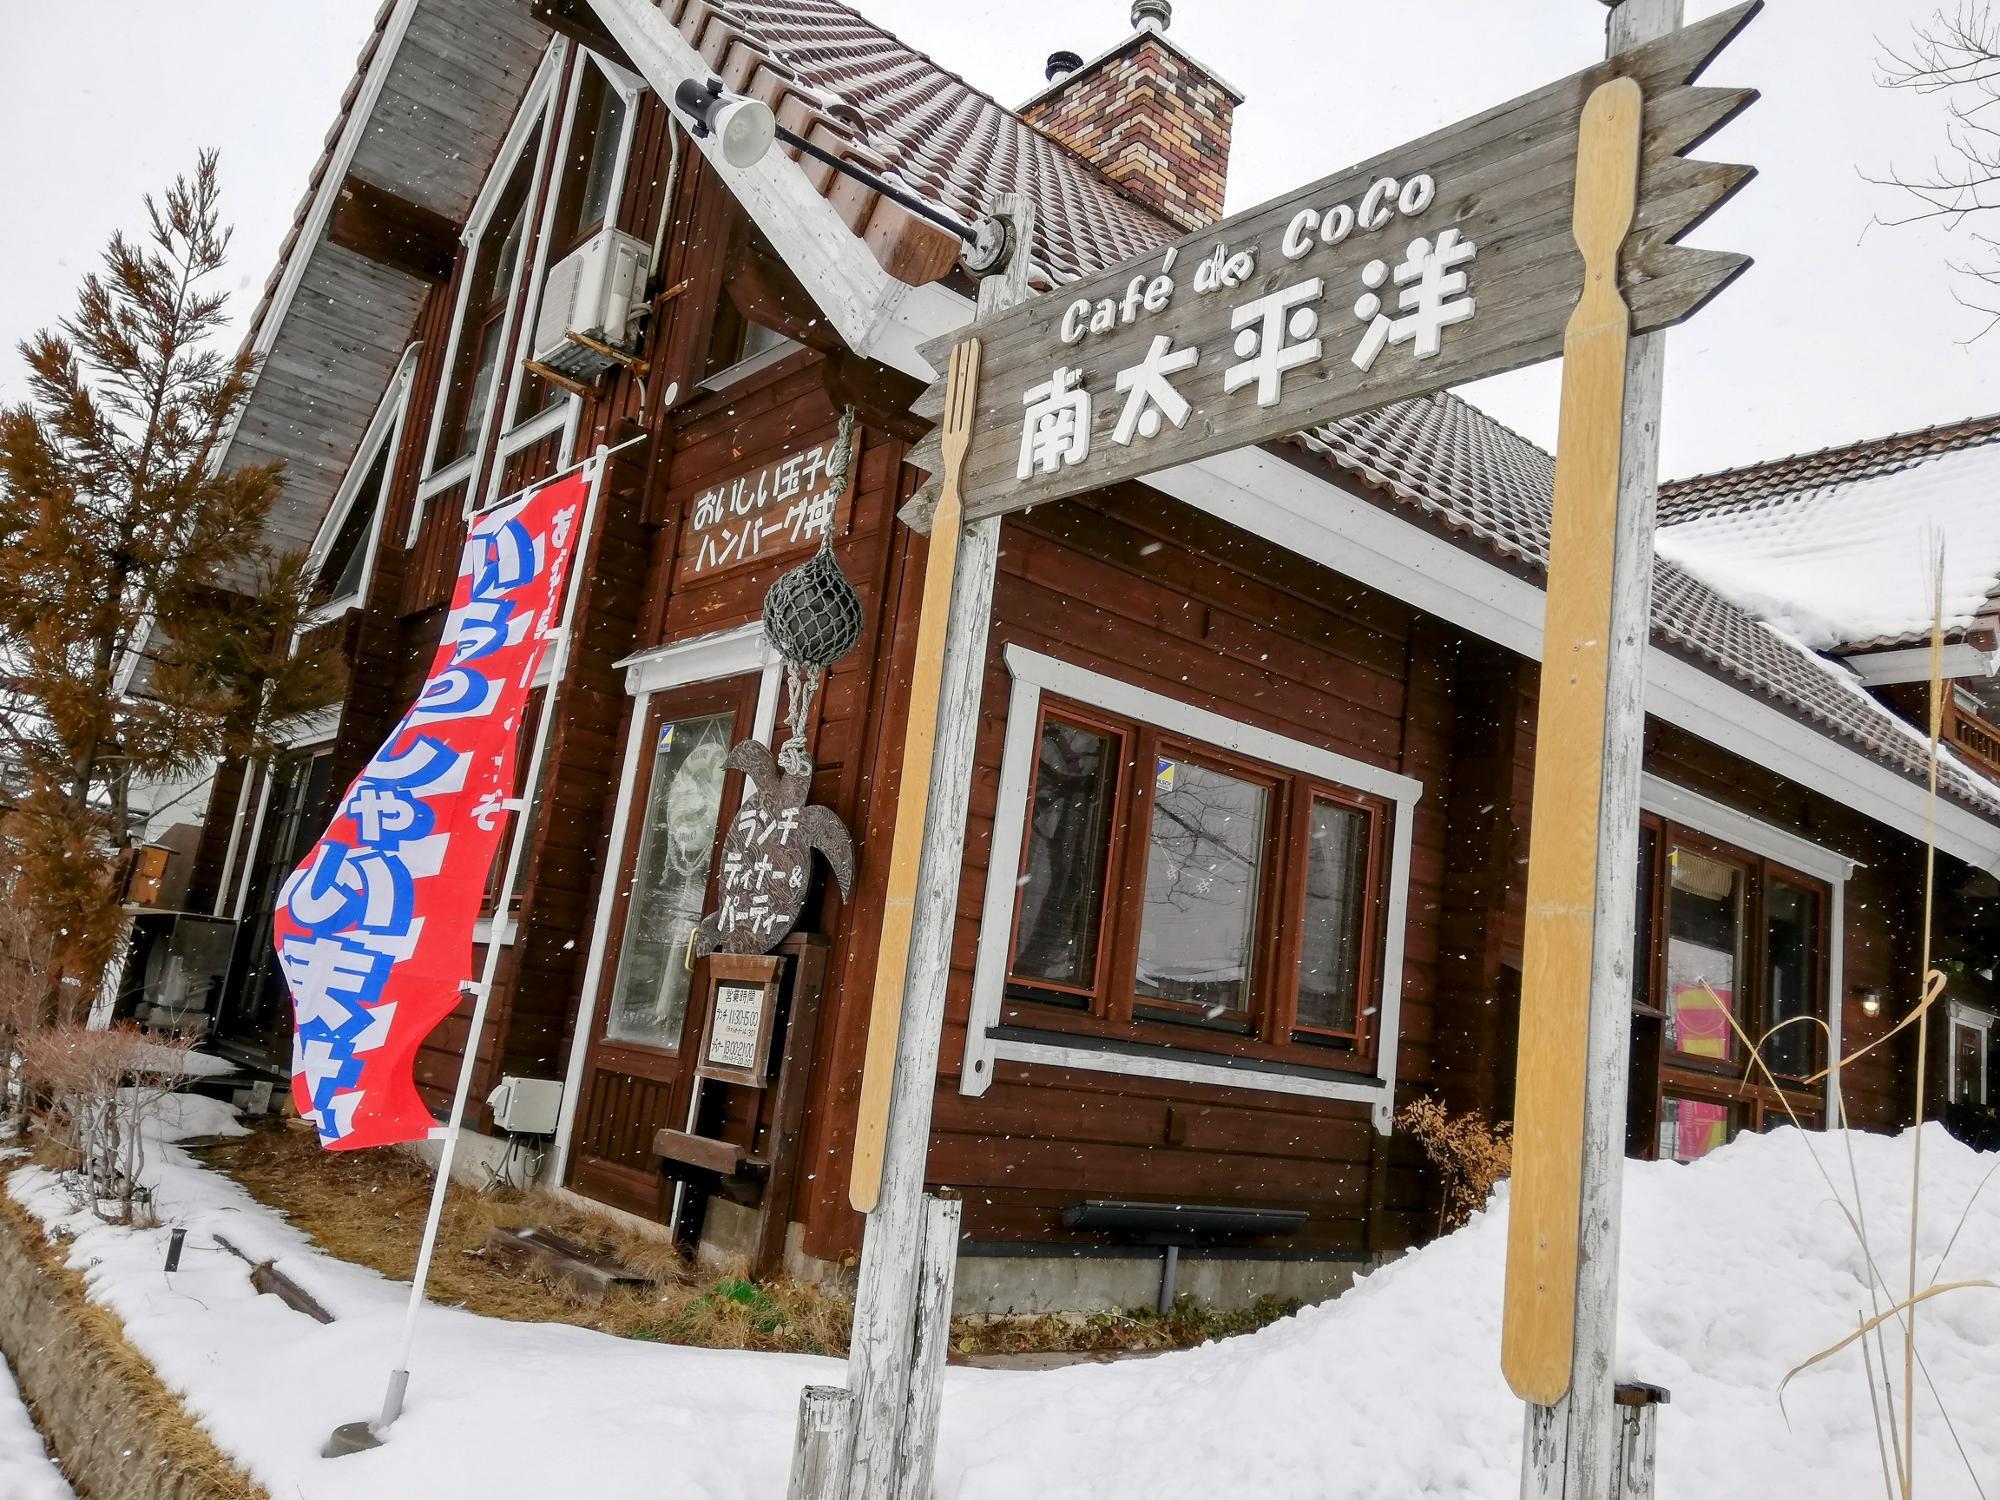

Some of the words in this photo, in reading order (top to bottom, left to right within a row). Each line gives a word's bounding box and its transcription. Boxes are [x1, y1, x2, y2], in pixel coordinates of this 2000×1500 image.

[1060, 246, 1175, 345] Café
[1193, 242, 1256, 294] de
[1282, 173, 1436, 261] CoCo
[1016, 228, 1477, 482] 南太平洋
[695, 489, 835, 573] ハンバーグ丼
[738, 806, 800, 848] ランチ
[717, 895, 790, 935] パーティー
[726, 988, 756, 1004] 営業時間
